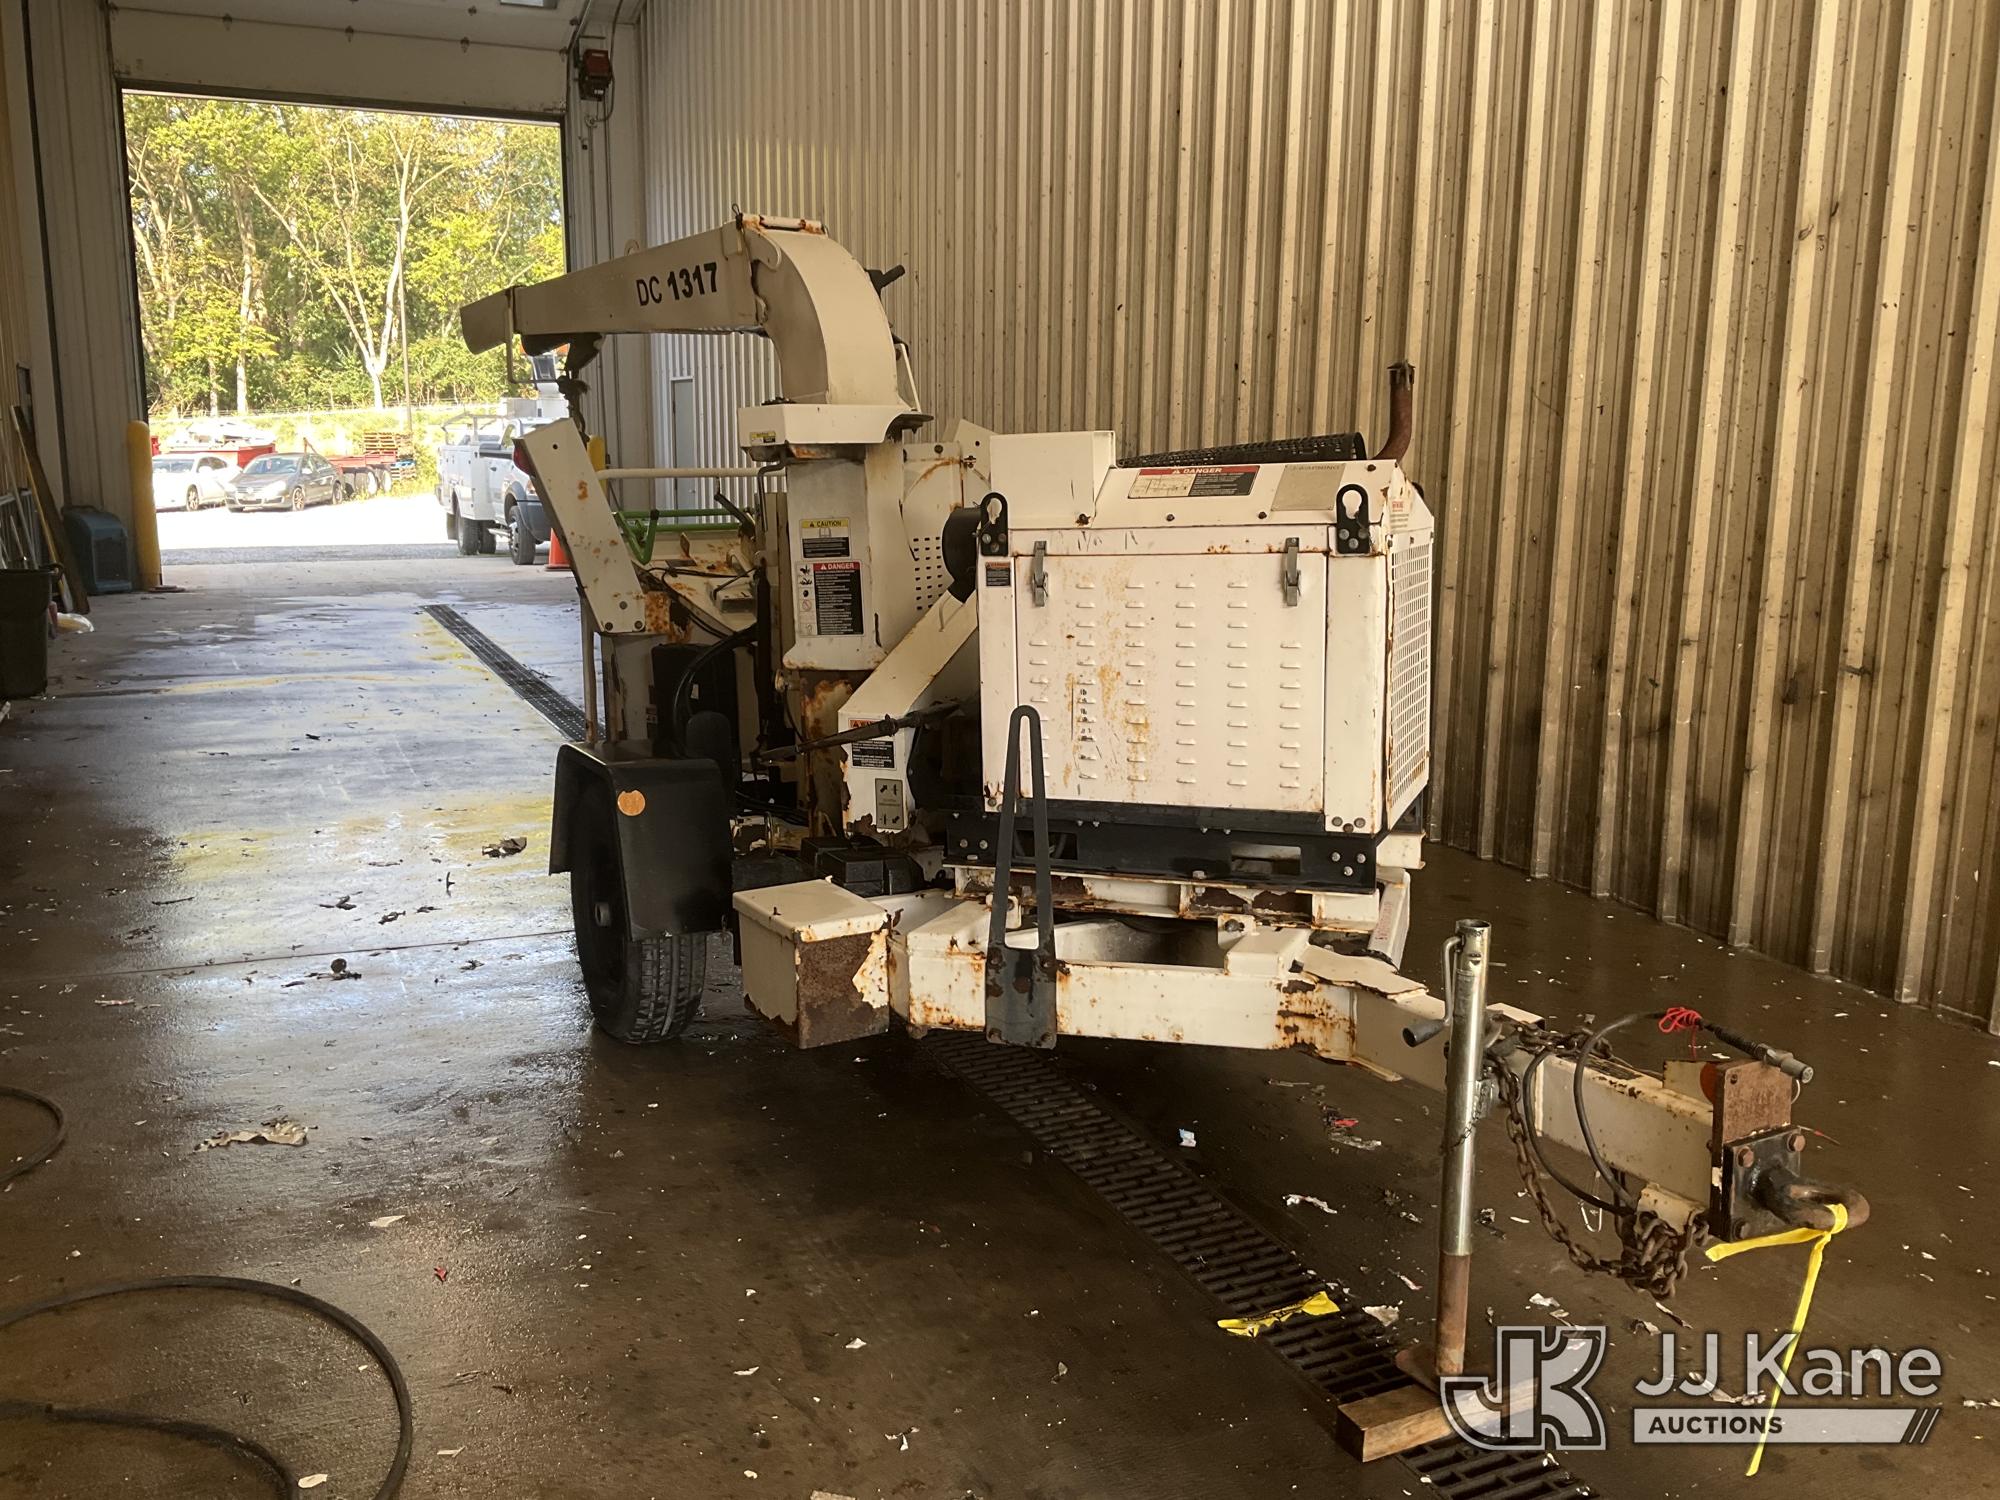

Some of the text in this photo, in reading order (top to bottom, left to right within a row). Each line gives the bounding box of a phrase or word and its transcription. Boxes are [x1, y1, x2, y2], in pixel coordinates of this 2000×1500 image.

[636, 262, 718, 307] DC 1317
[816, 520, 842, 528] CAUTION
[827, 562, 855, 570] DANGER
